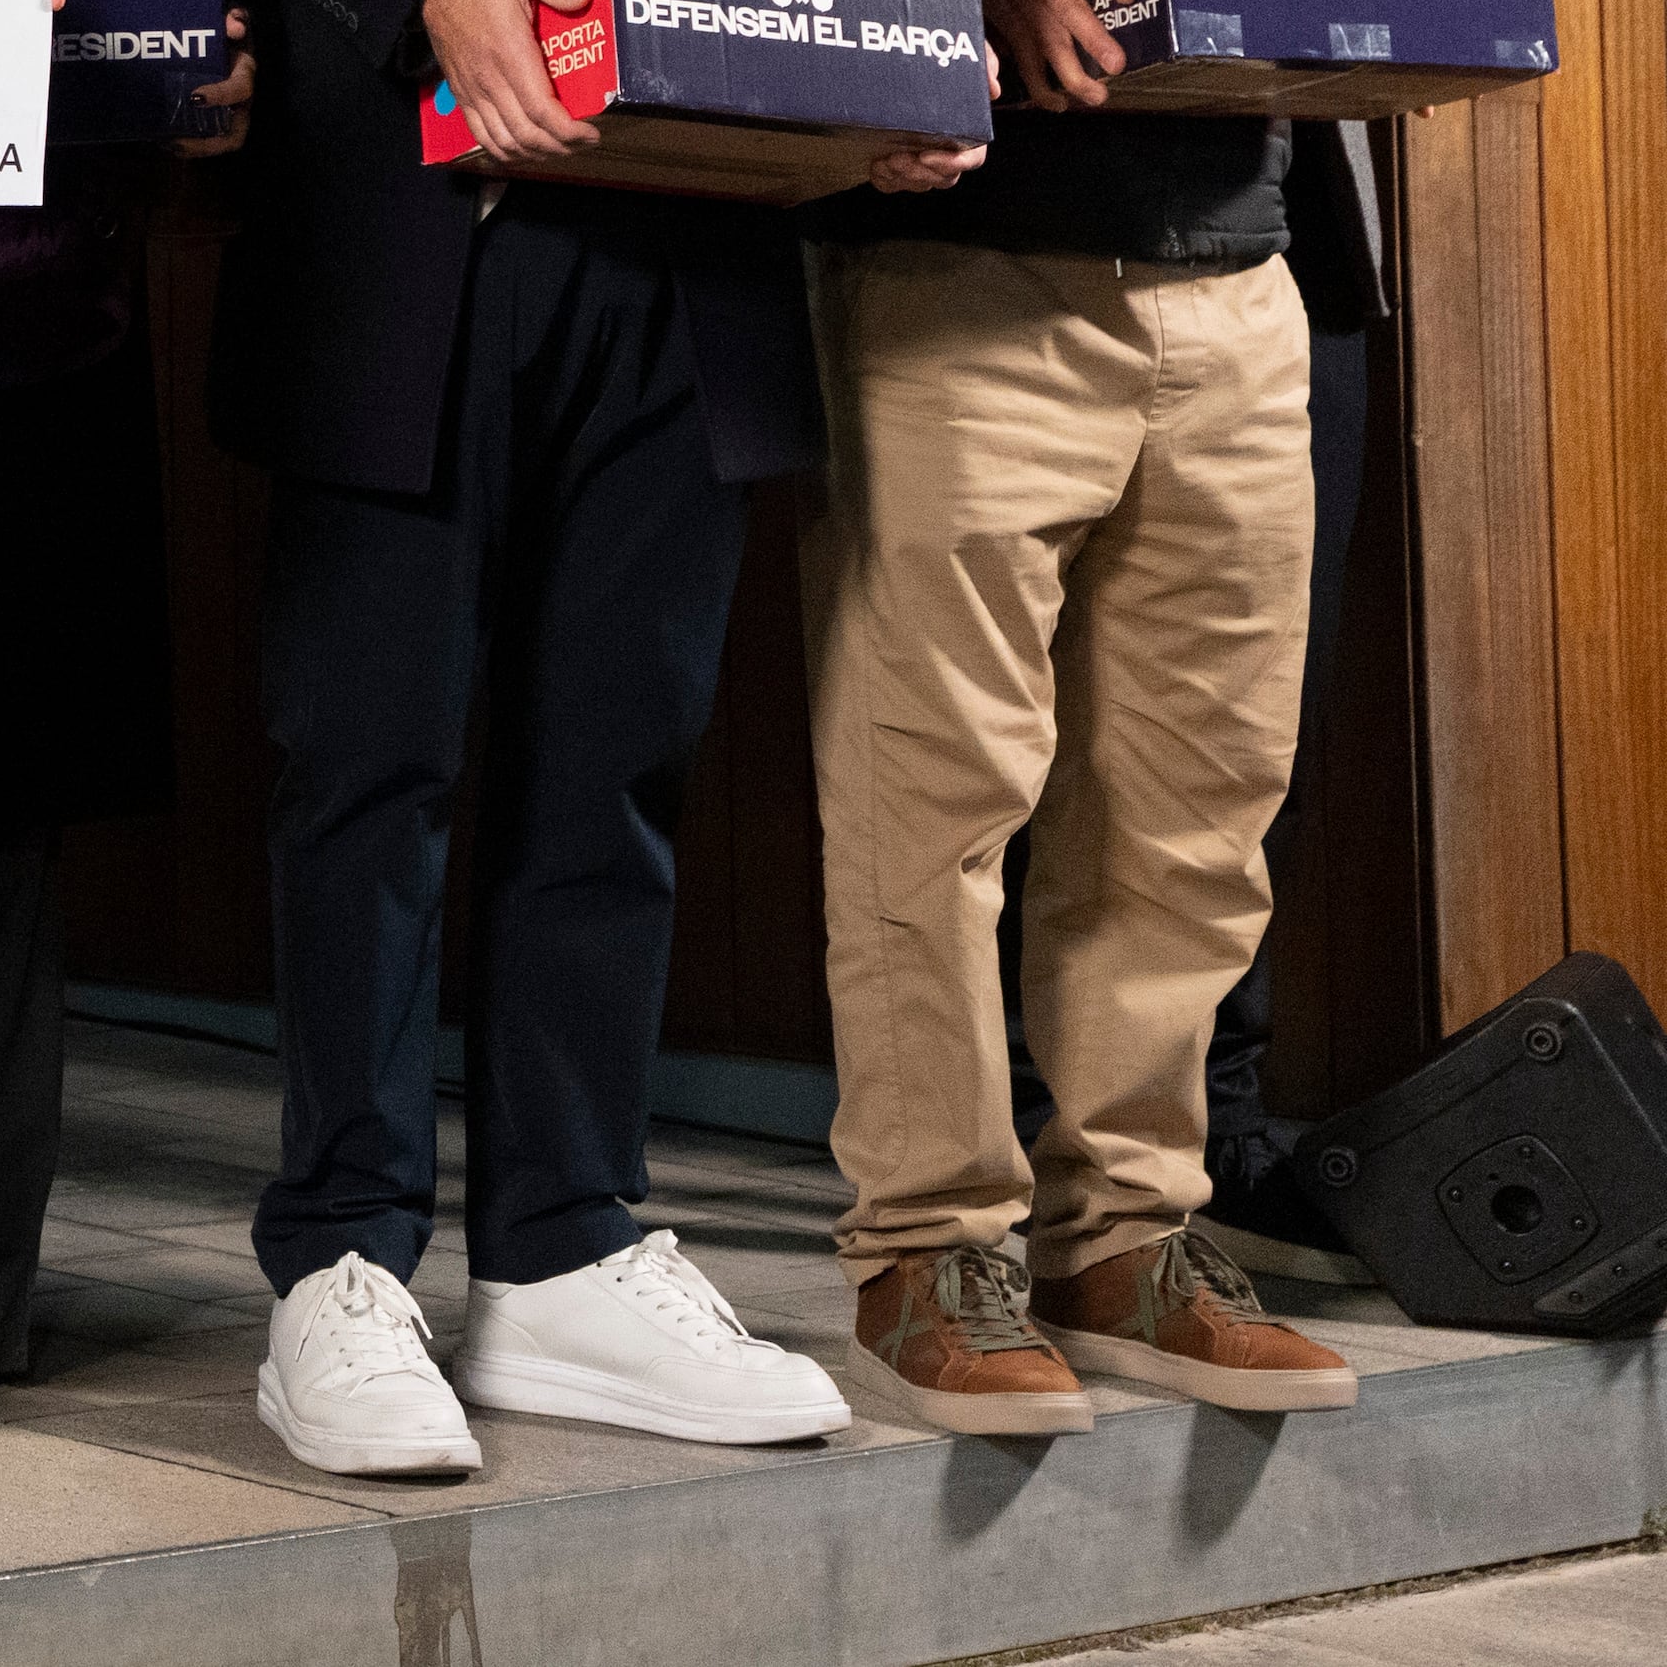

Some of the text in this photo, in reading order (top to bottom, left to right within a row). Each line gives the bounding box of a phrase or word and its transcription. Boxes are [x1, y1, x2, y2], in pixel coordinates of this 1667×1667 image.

[52, 30, 215, 62] ESIDENT
[542, 19, 605, 57] APORTA
[812, 15, 858, 49] EL
[860, 20, 979, 68] BARÇA
[548, 40, 606, 78] SIDENT
